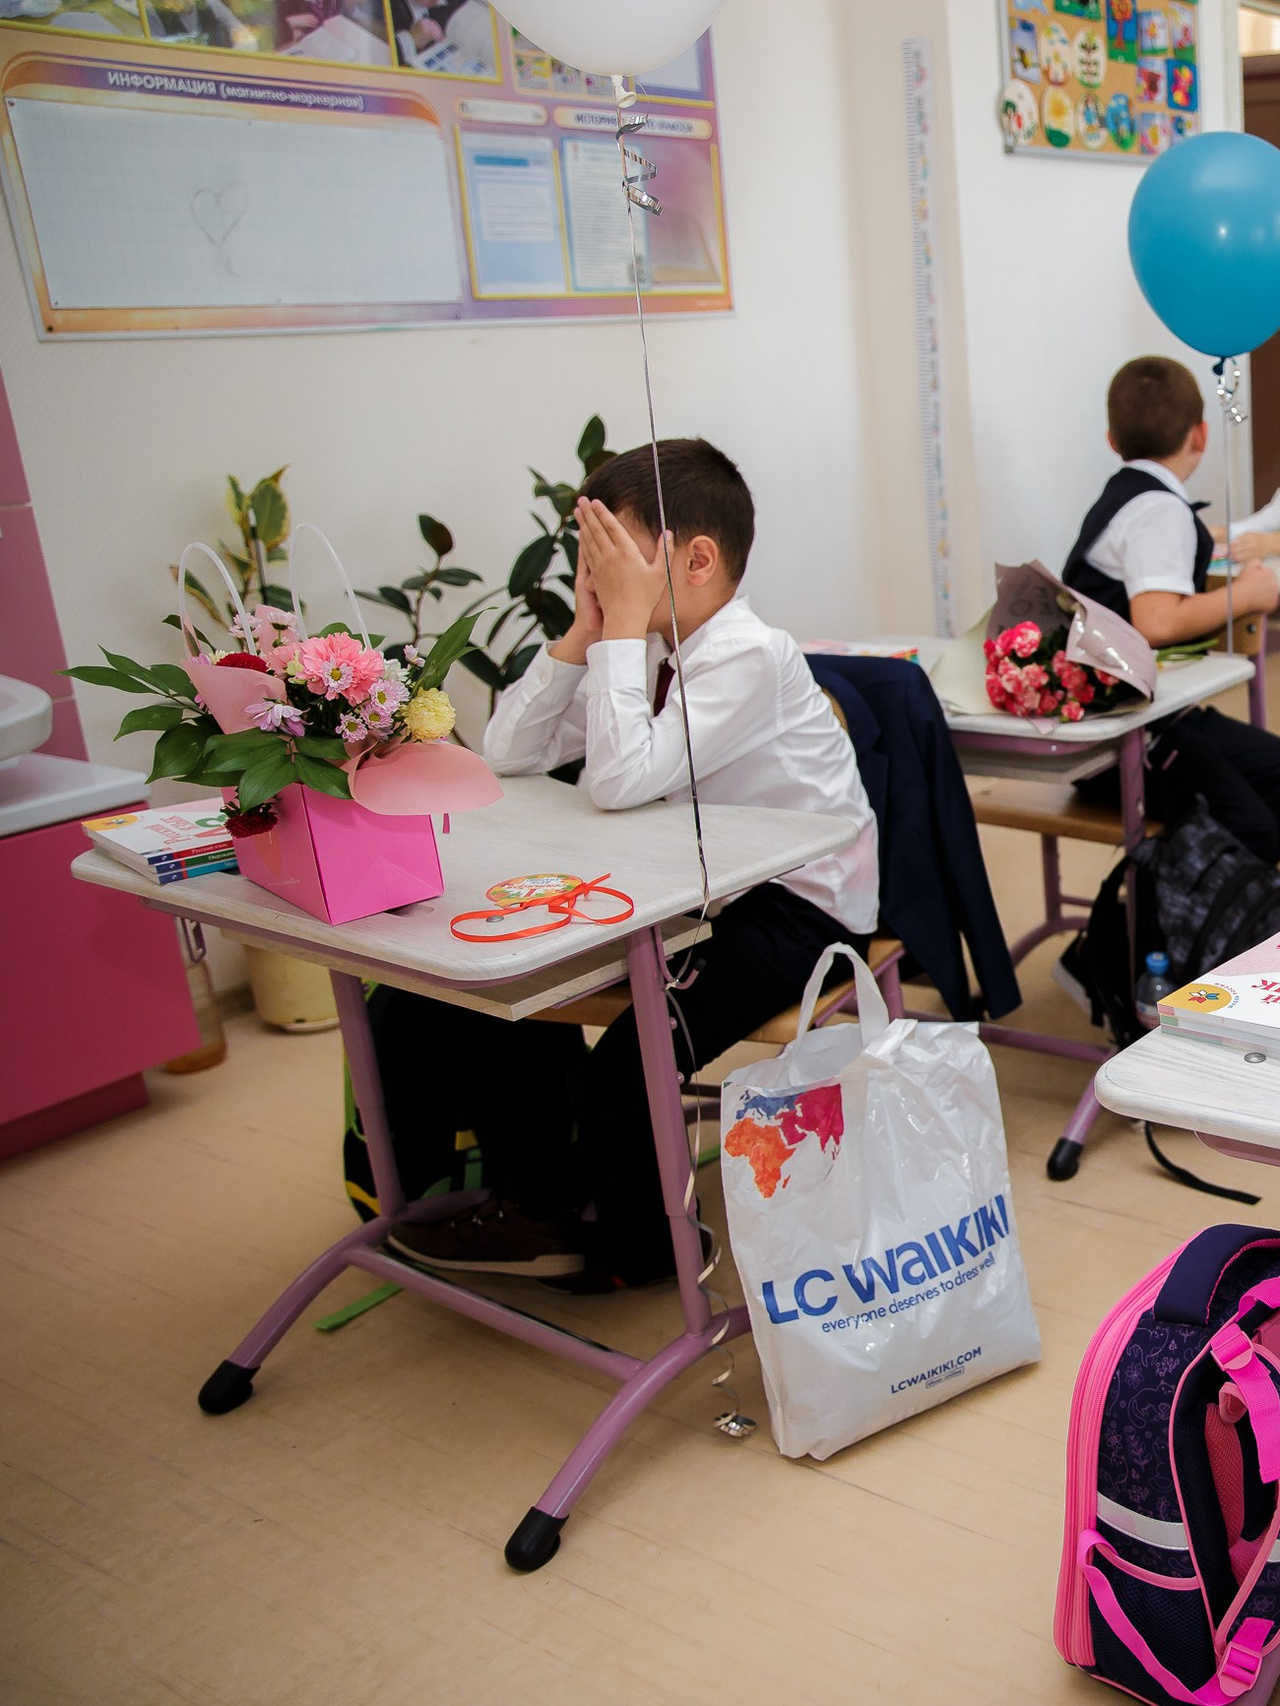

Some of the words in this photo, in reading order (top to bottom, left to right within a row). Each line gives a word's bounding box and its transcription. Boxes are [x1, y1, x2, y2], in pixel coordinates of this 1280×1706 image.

[107, 71, 217, 96] ИНФОРМАЦИЯ
[220, 82, 365, 112] (магнитно-маркерная)
[762, 1268, 838, 1324] LC
[821, 1305, 887, 1333] everyone
[889, 1285, 940, 1315] deserves
[940, 1280, 954, 1293] to
[954, 1266, 979, 1287] dress
[979, 1251, 997, 1271] well
[890, 1346, 982, 1394] LCWAIKIKI.COM
